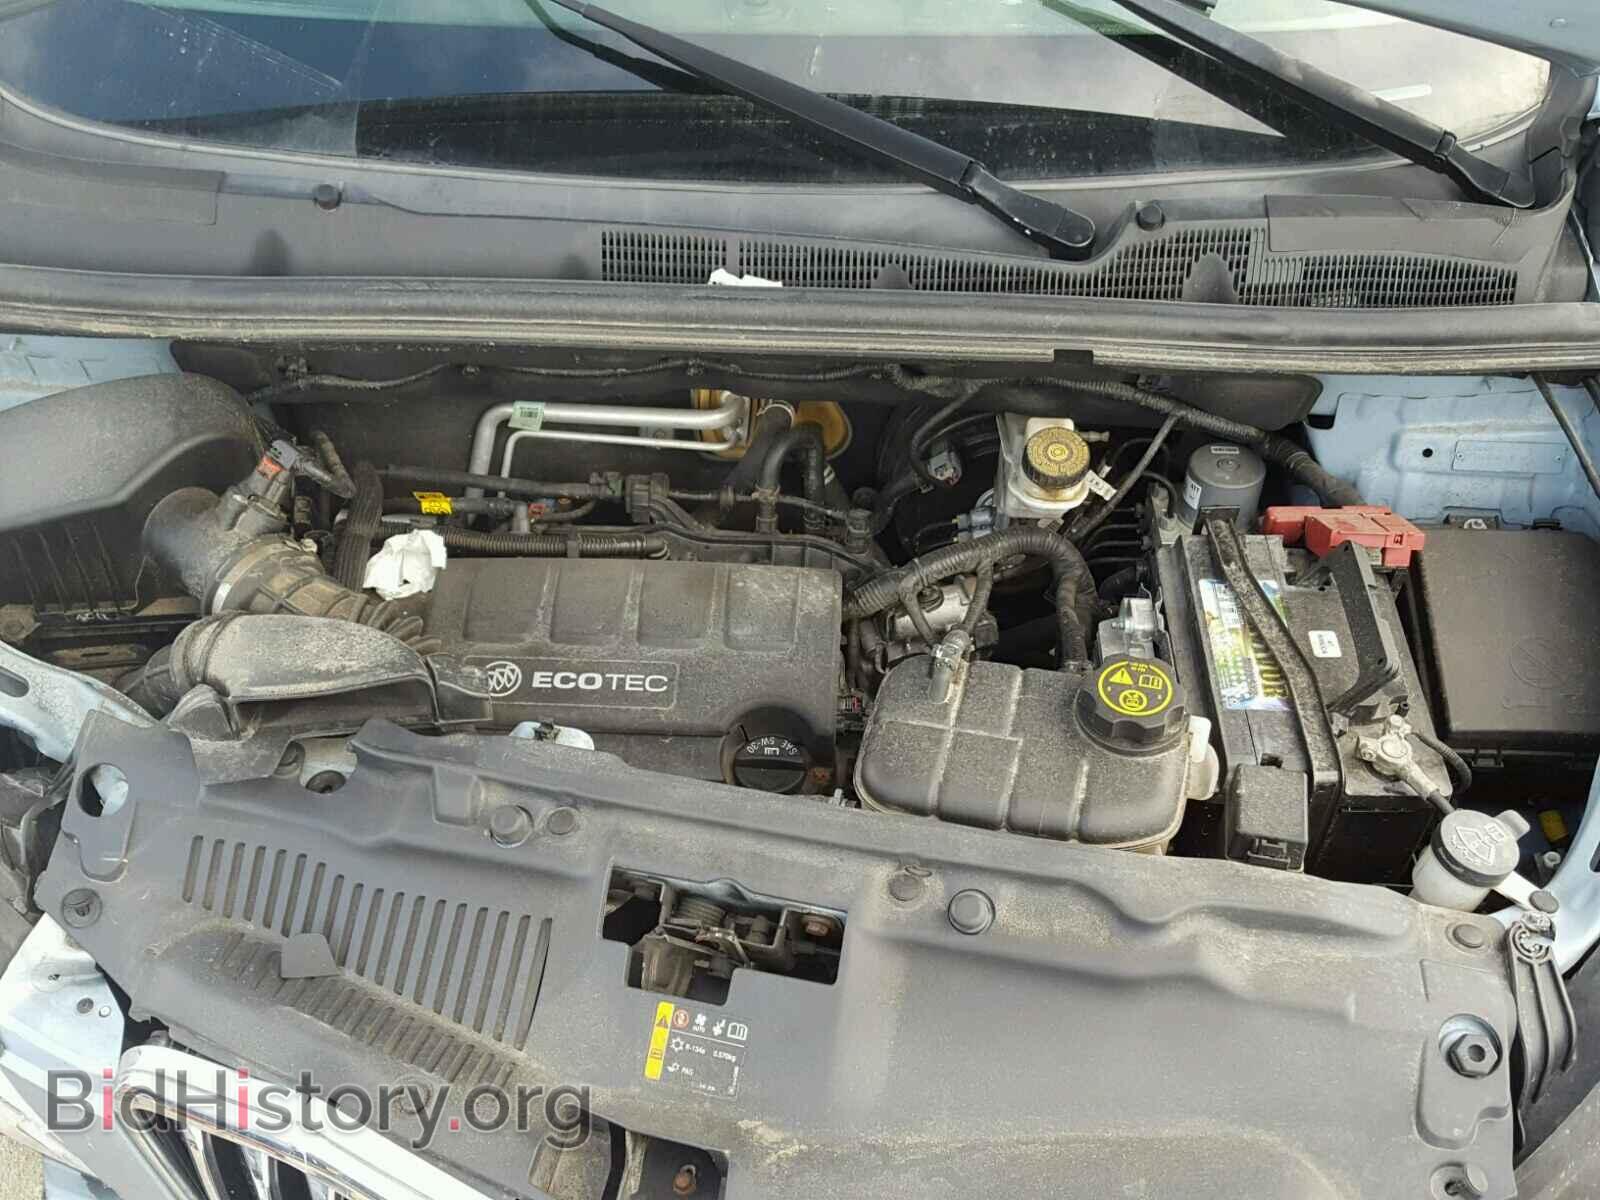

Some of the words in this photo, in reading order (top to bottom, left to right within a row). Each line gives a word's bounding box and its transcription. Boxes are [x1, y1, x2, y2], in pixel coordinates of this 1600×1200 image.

[531, 671, 668, 692] ECOTEC
[746, 736, 776, 754] 5W-30
[781, 739, 798, 756] SAE
